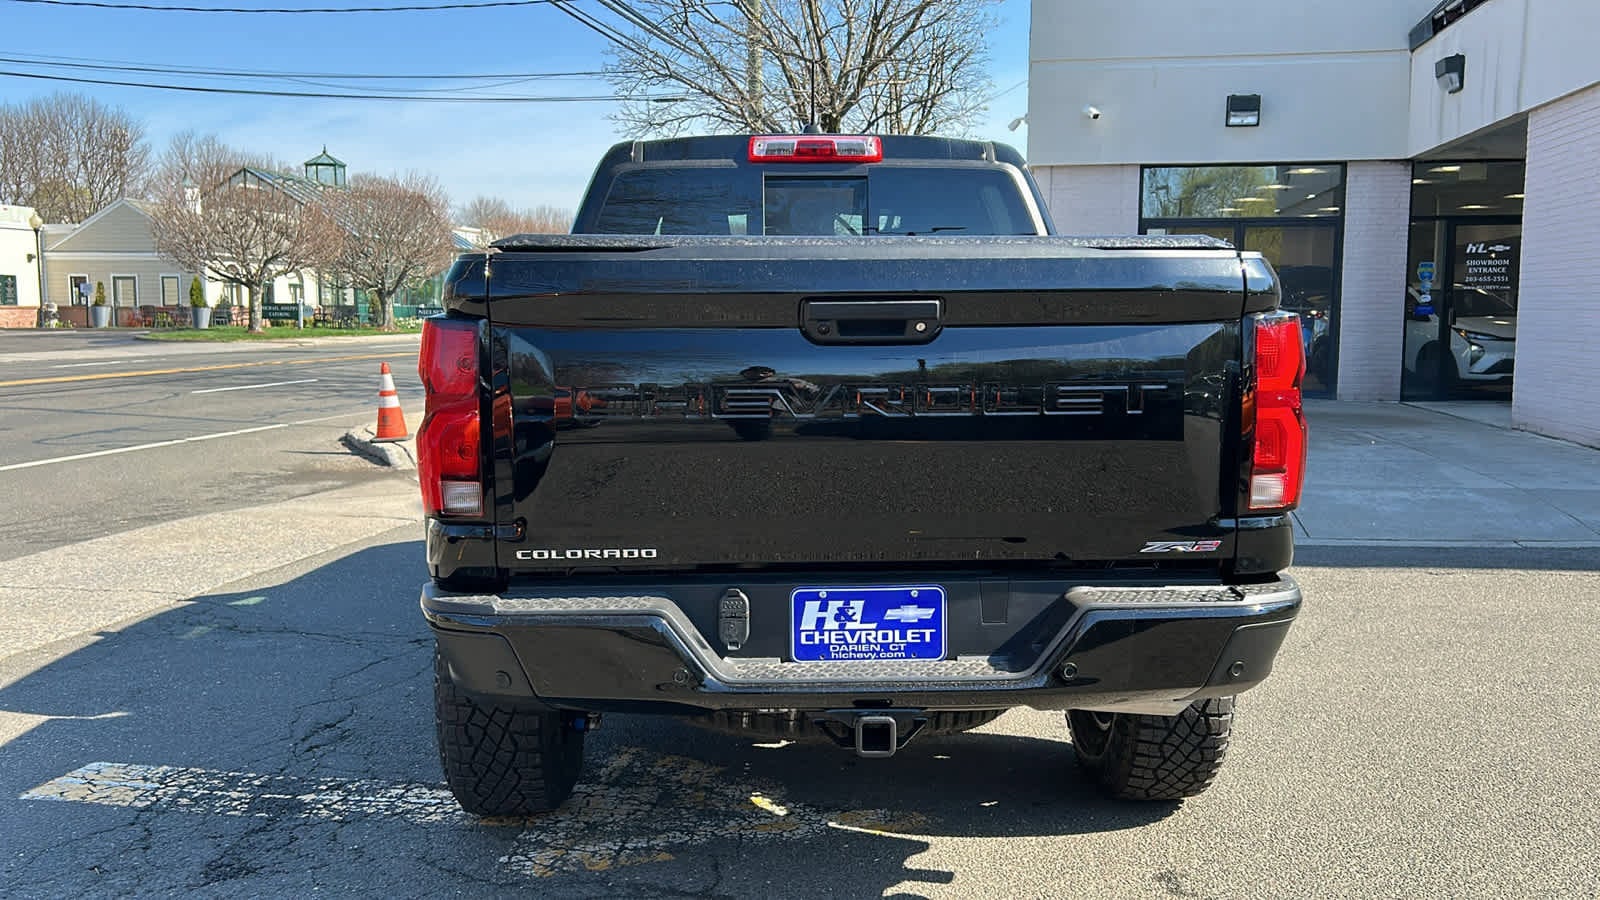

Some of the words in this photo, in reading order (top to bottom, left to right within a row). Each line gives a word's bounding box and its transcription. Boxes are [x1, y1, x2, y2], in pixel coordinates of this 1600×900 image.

[573, 382, 1168, 419] CHEVROLET
[1139, 540, 1222, 553] ZR2
[516, 549, 657, 560] COLORADO
[799, 600, 878, 631] H&L
[800, 629, 937, 645] CHEVROLET
[829, 643, 885, 653] DARIEN,
[889, 643, 907, 652] CT
[831, 651, 906, 660] hlchevy.com
